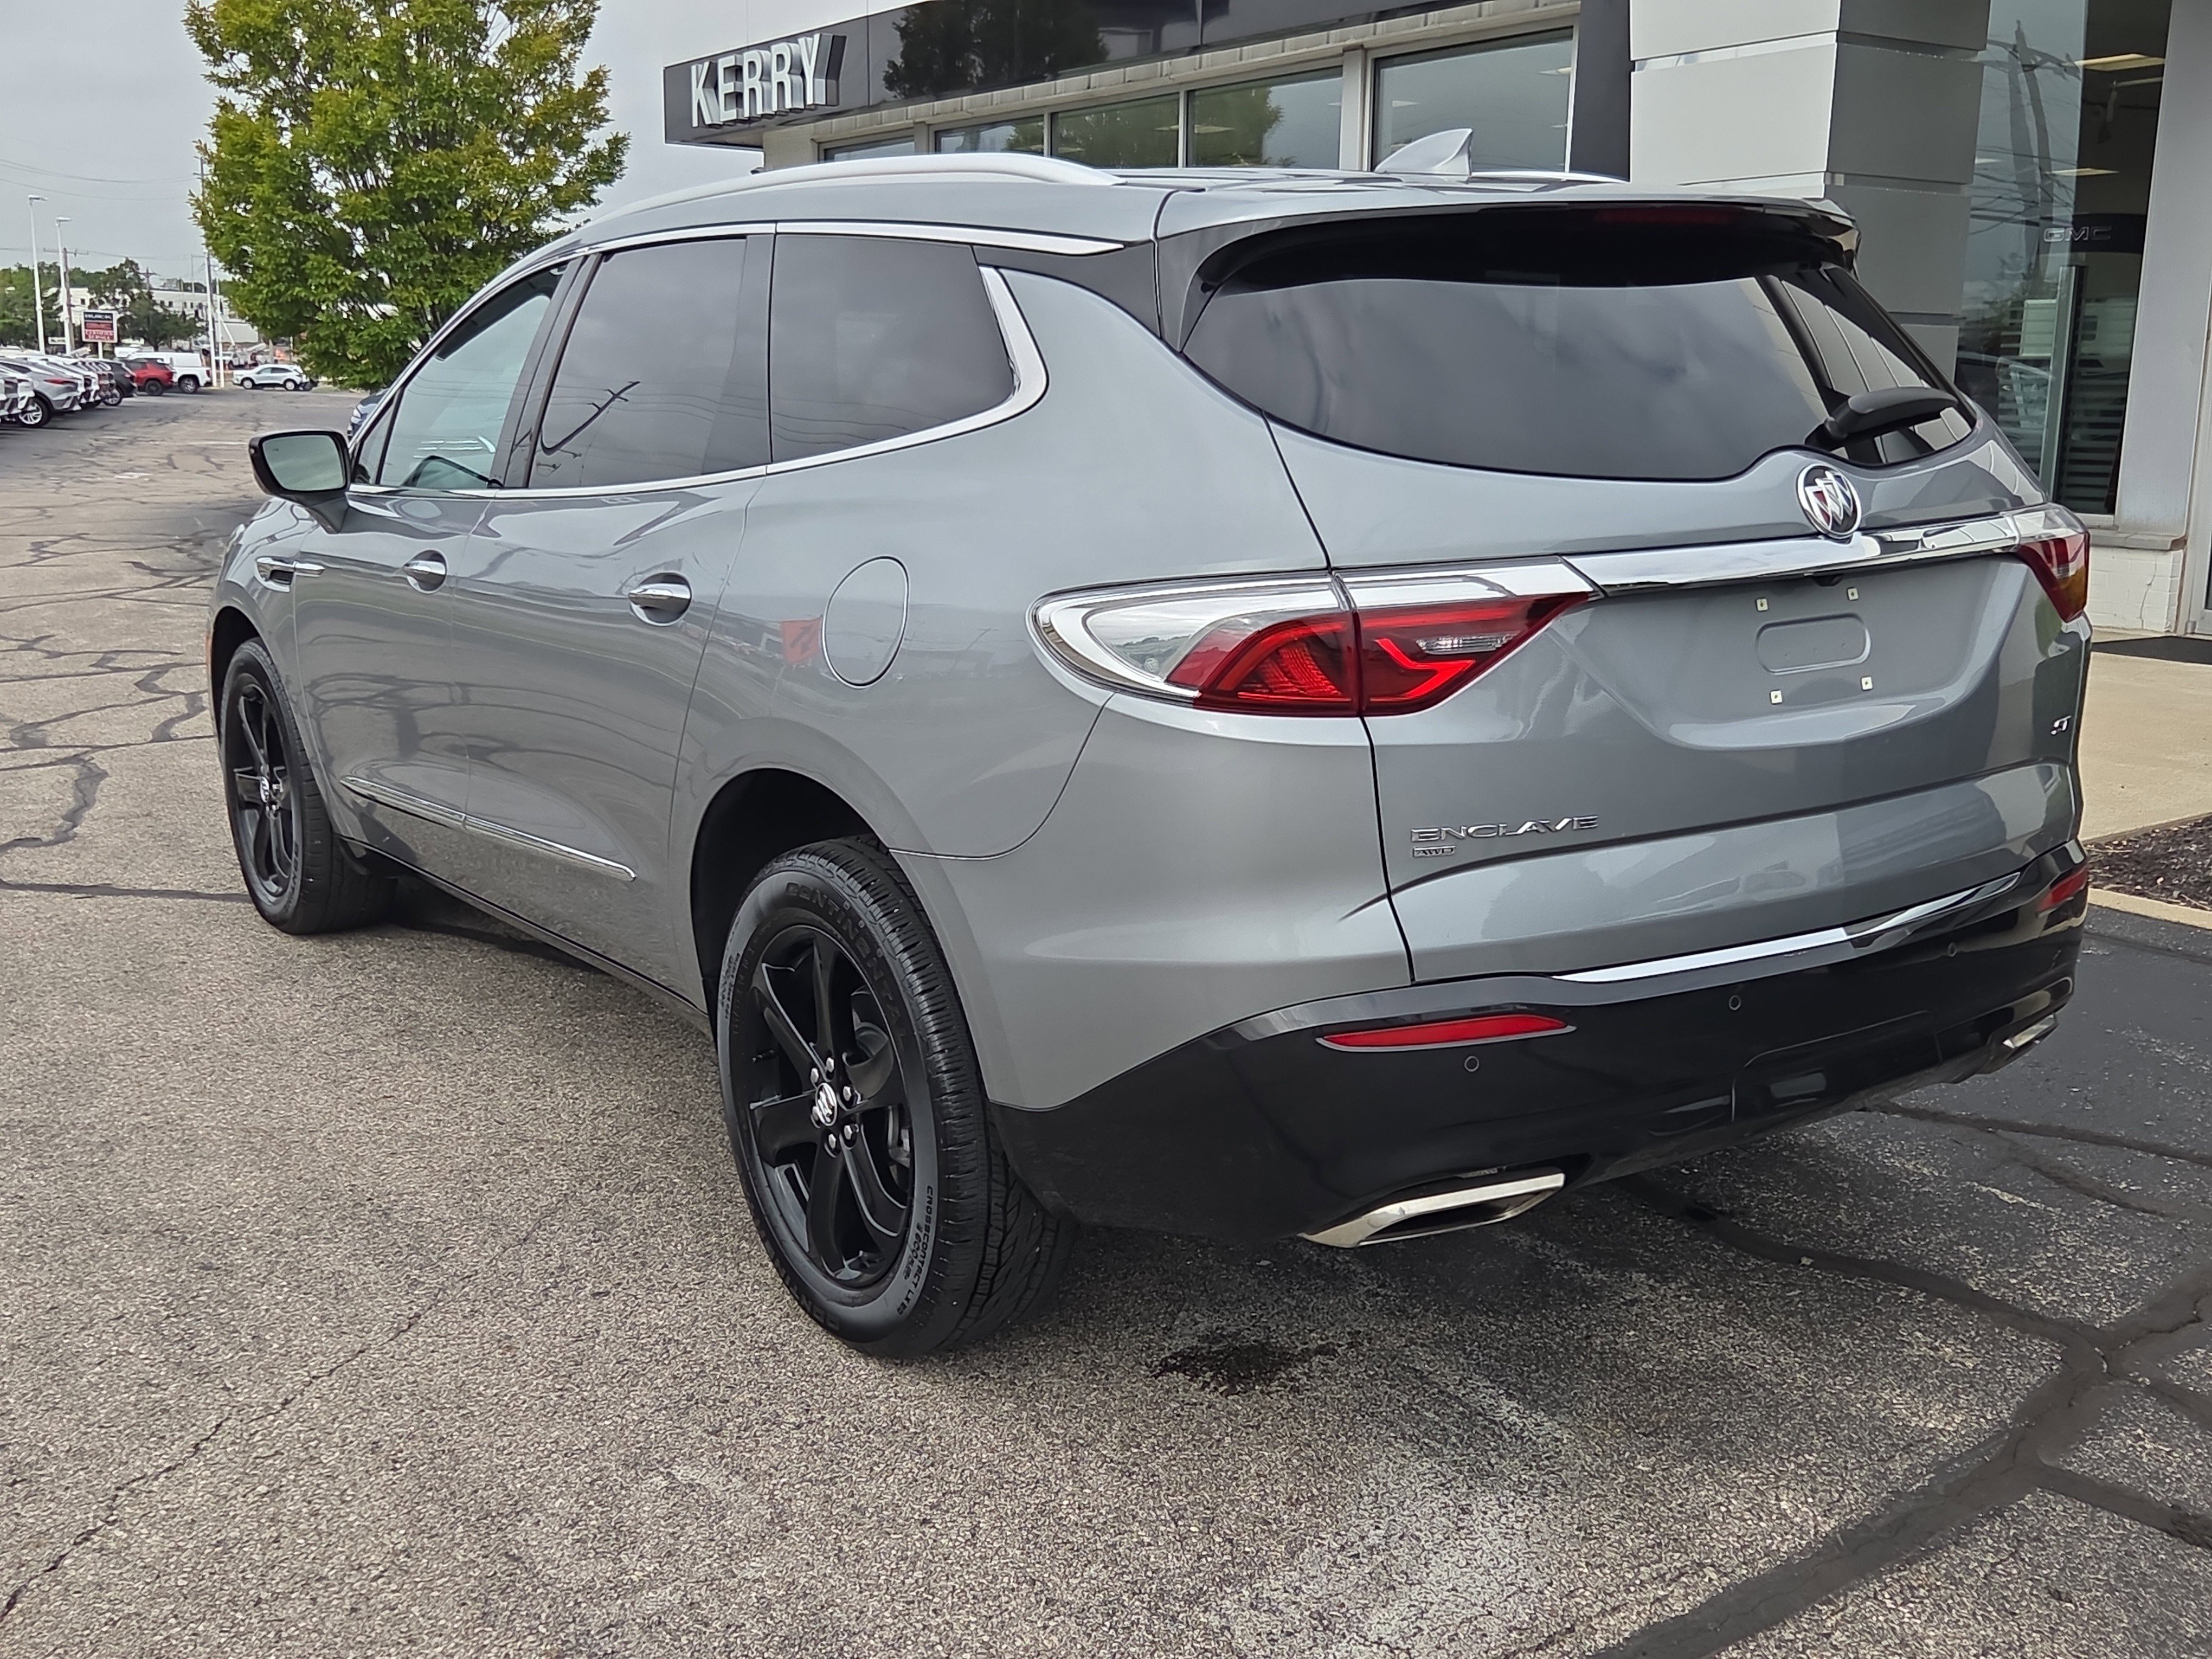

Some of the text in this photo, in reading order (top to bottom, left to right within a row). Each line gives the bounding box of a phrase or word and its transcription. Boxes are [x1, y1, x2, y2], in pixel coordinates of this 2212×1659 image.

[691, 33, 833, 128] KERRY
[2043, 225, 2112, 242] GMC
[1411, 814, 1599, 842] ENCLAVE
[1413, 846, 1456, 858] AWD
